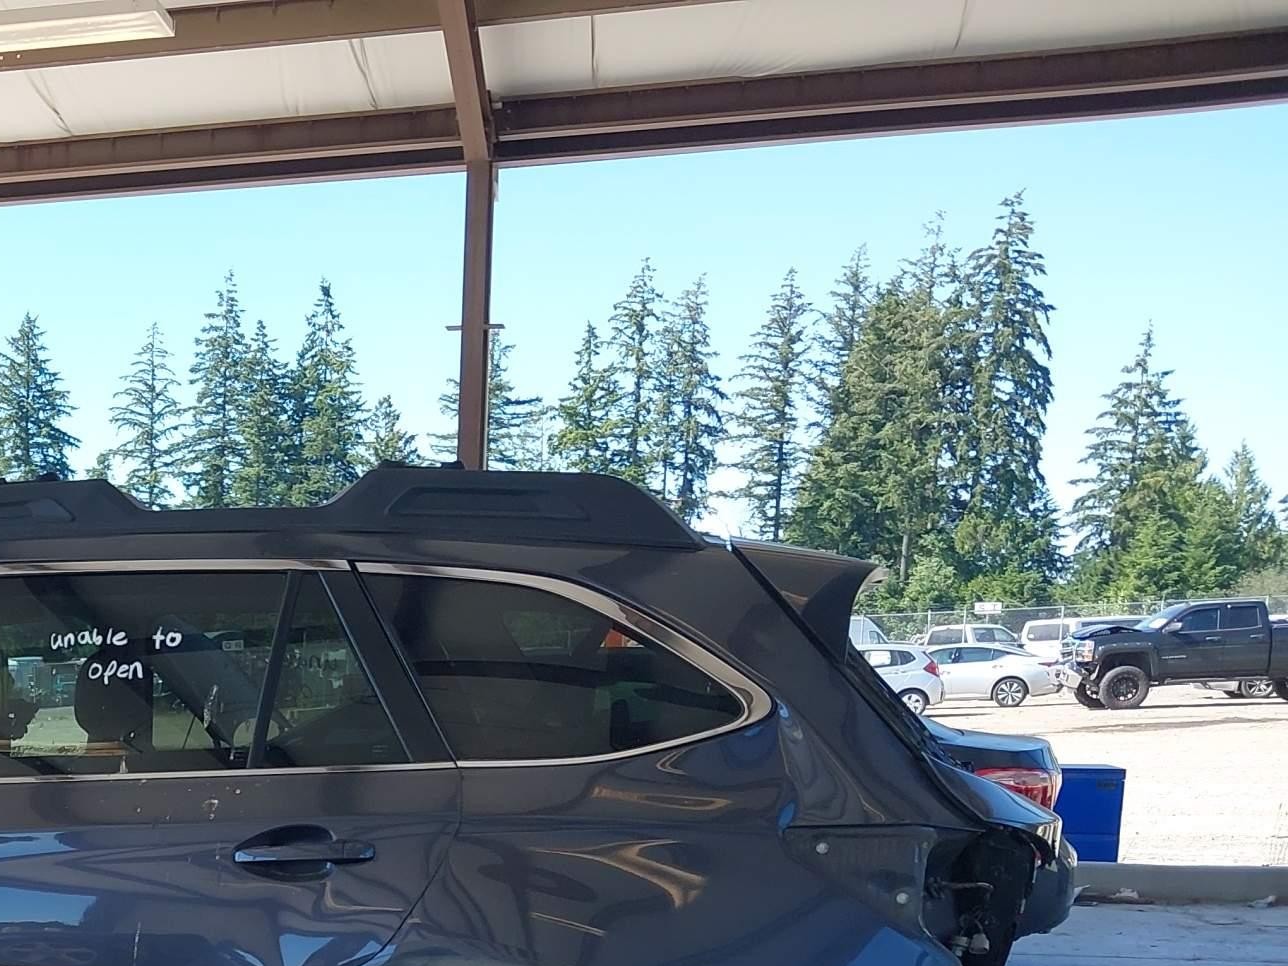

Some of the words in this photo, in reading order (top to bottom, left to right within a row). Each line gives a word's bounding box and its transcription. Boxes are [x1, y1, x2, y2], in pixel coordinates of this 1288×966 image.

[50, 628, 128, 650] unable
[152, 626, 182, 650] to
[88, 660, 144, 685] open
